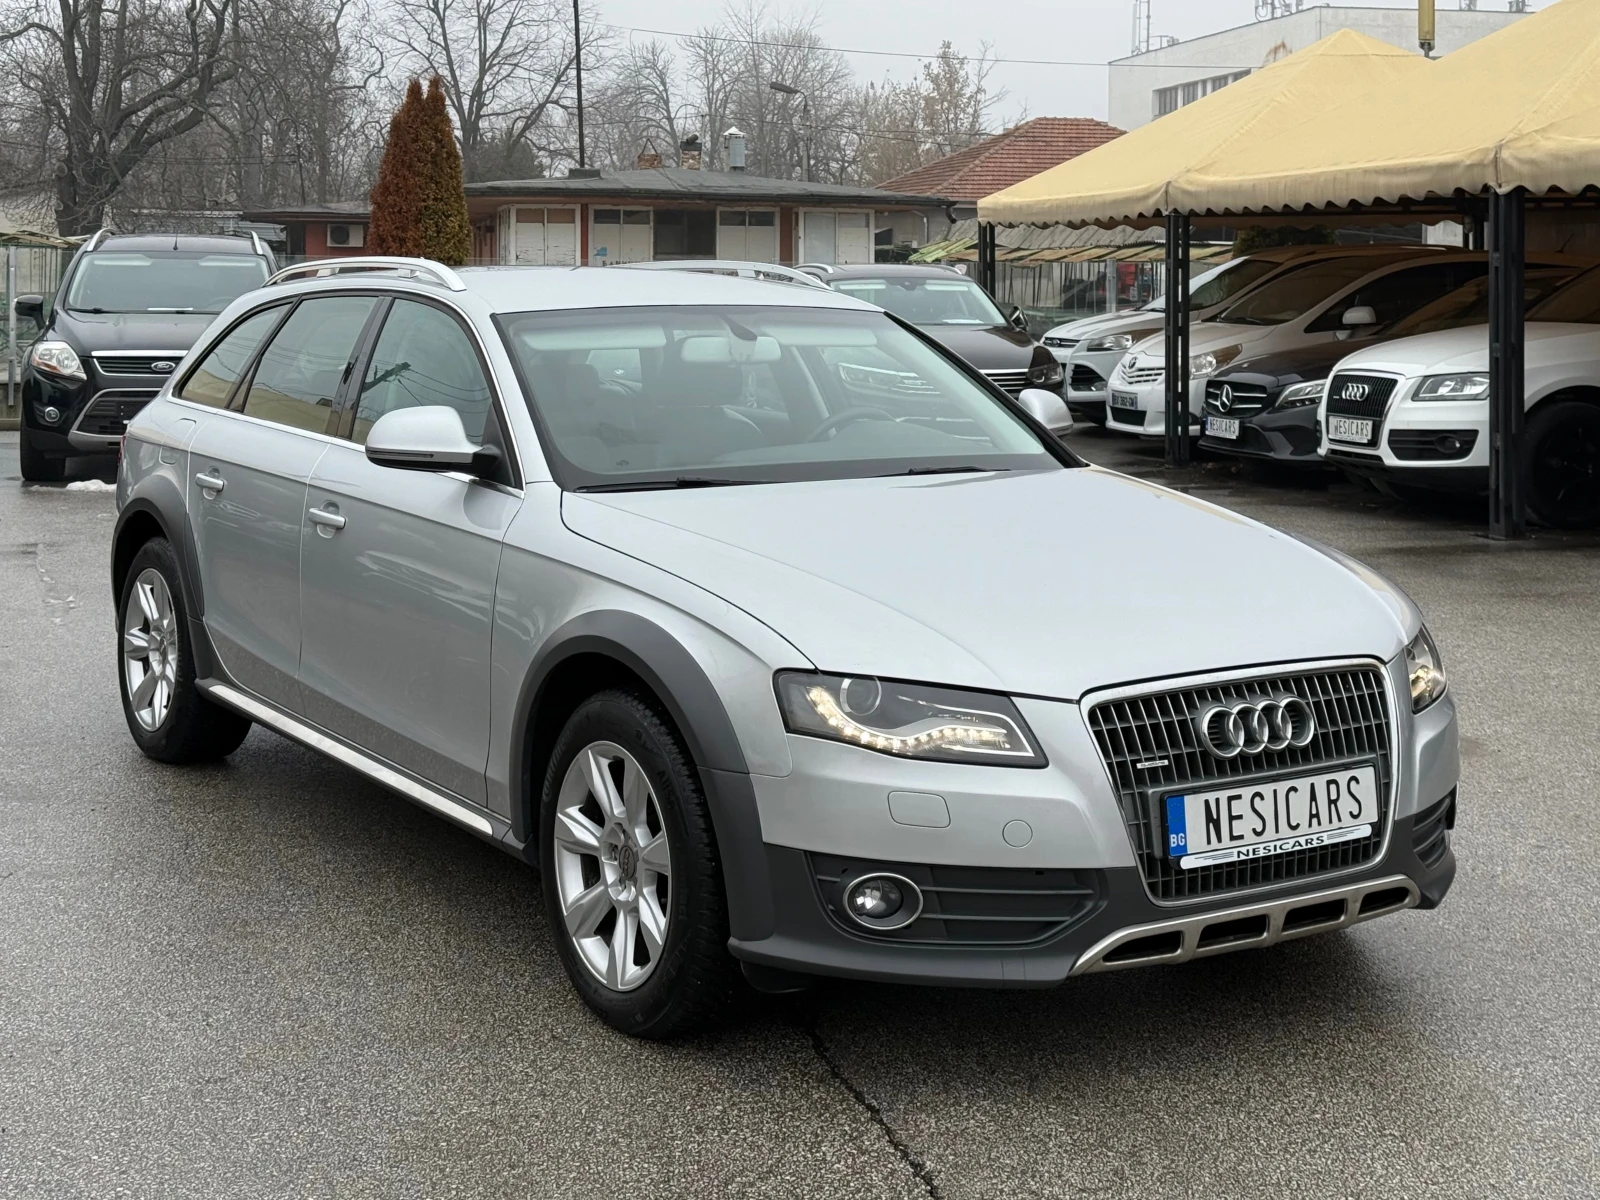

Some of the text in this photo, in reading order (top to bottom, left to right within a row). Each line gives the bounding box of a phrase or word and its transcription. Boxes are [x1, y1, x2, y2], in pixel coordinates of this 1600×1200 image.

[1209, 418, 1237, 434] NESICARS
[1334, 420, 1370, 438] NESICARS
[1203, 775, 1362, 845] NESICARS
[1170, 832, 1186, 847] BG
[1236, 835, 1325, 859] NESICARS
